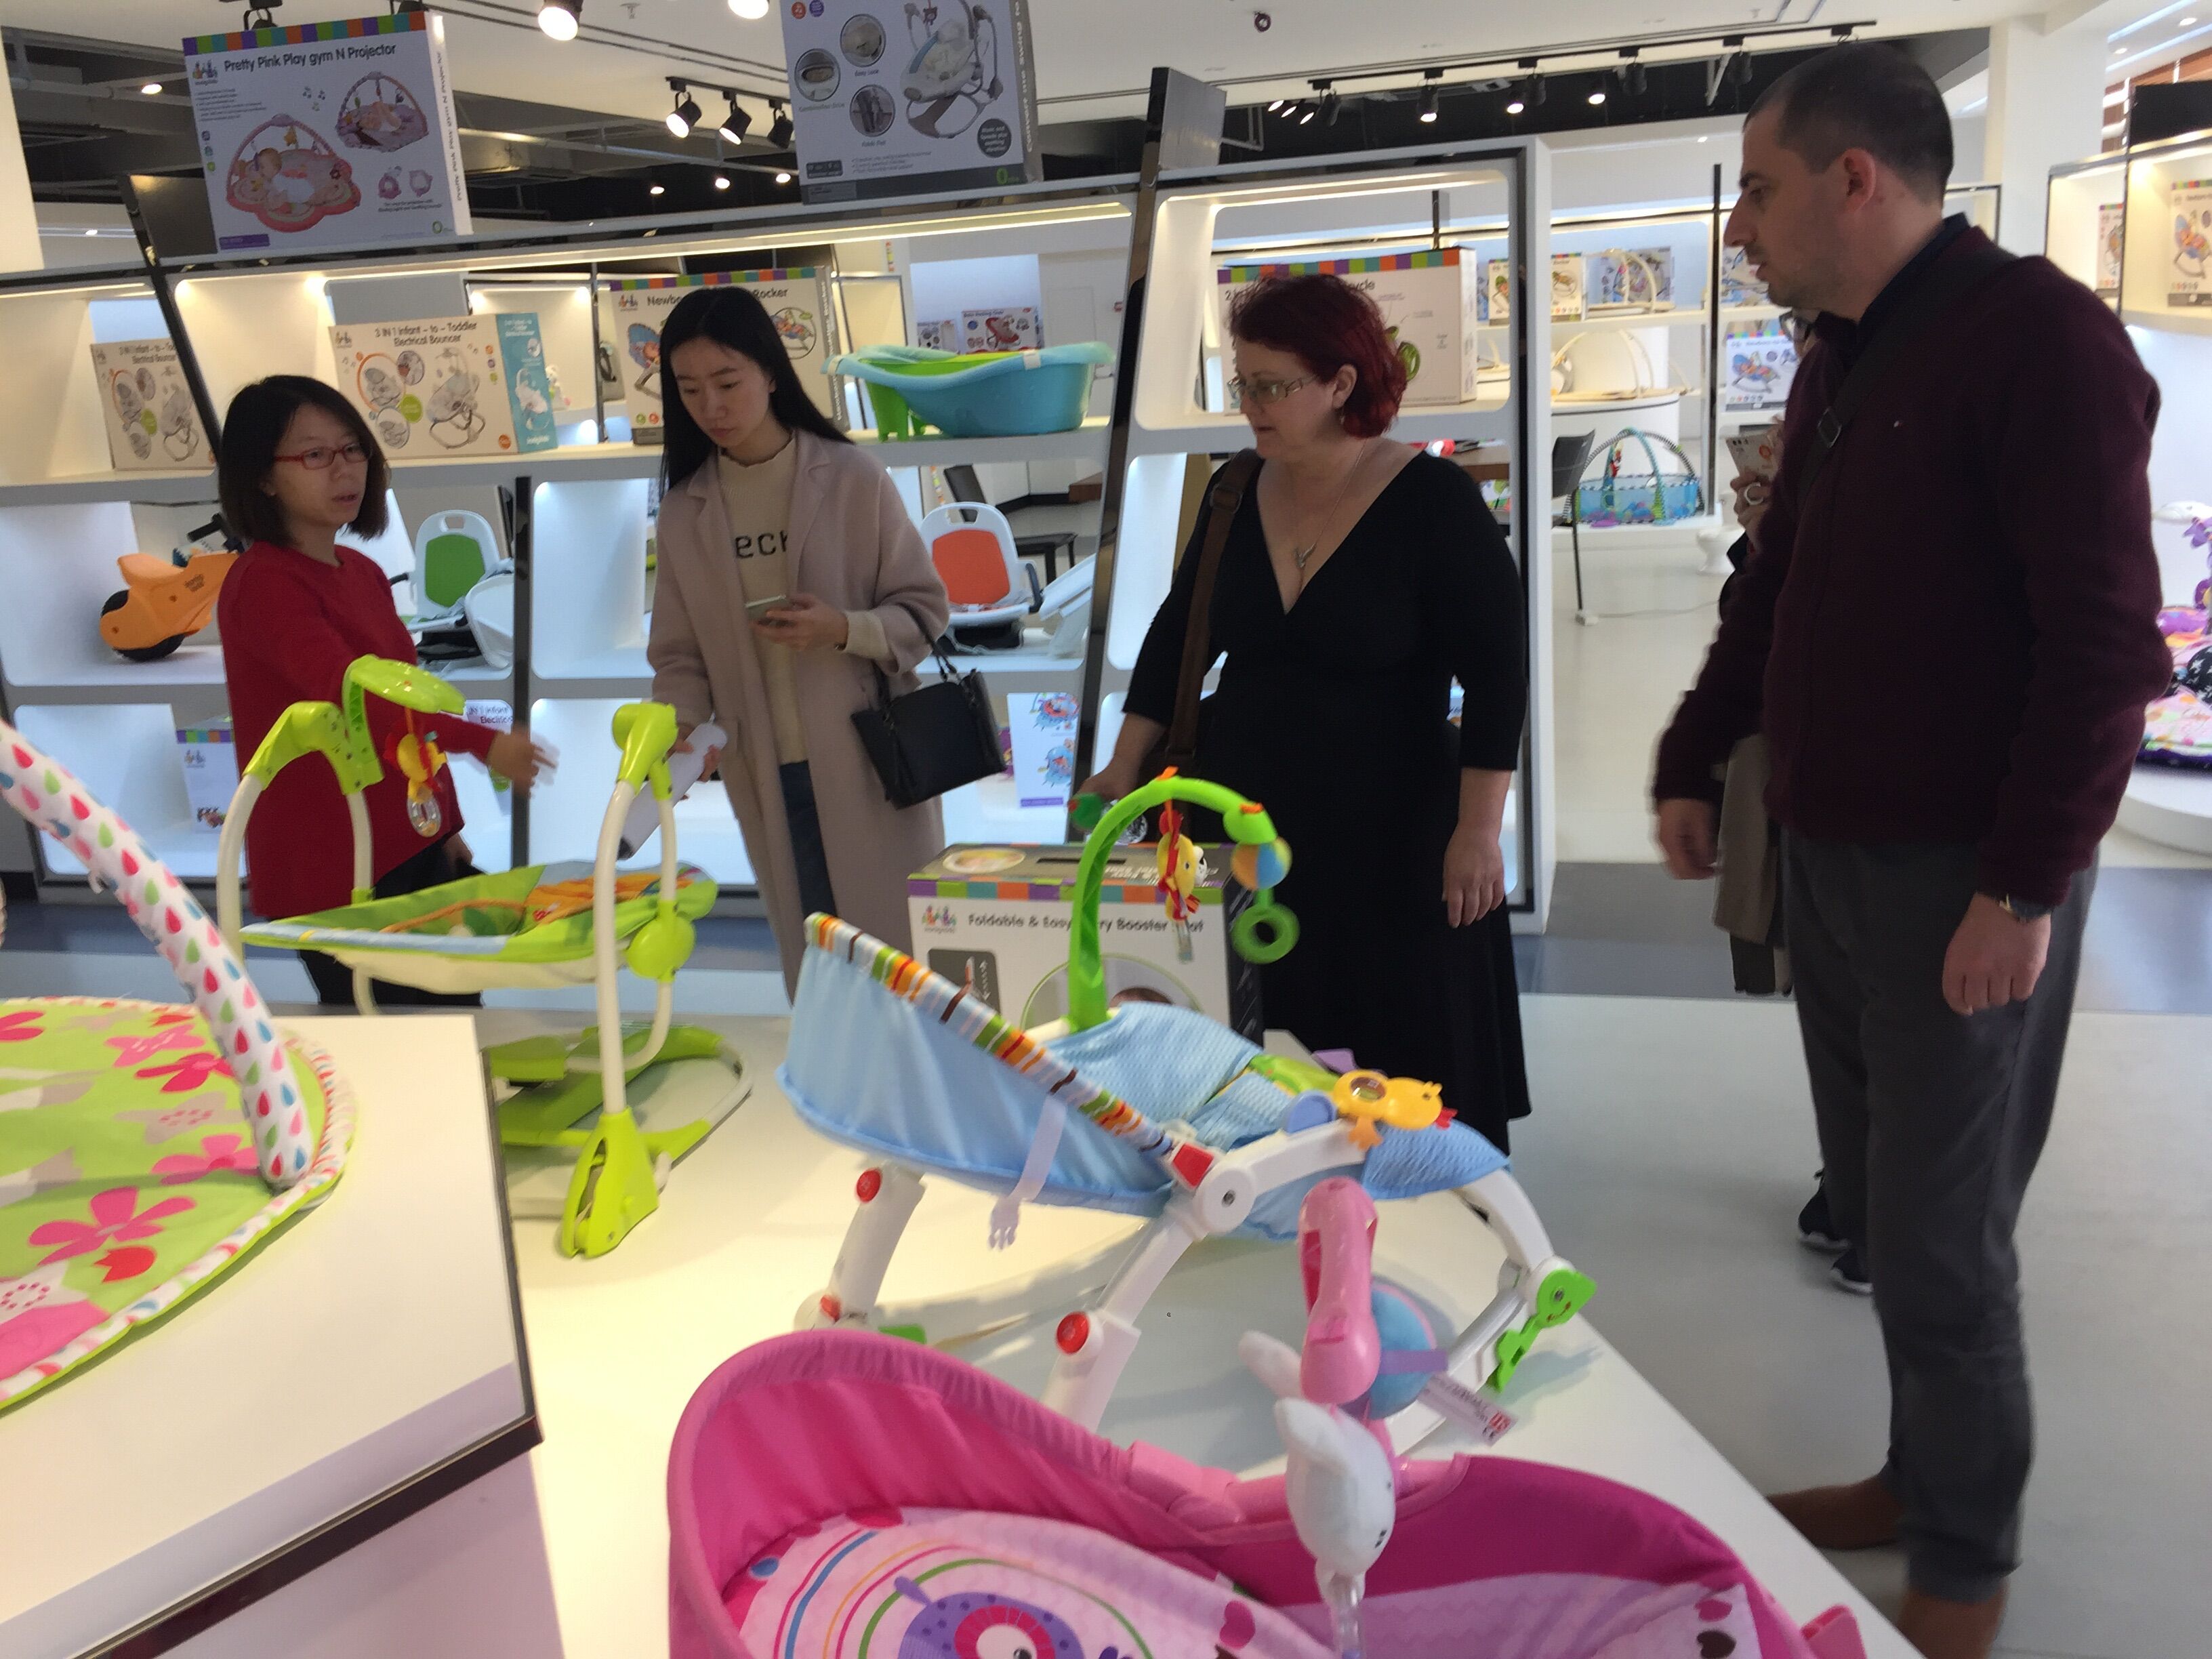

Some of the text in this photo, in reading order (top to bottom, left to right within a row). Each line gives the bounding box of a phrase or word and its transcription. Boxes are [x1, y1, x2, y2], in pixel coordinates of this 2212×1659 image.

[224, 44, 397, 73] Pretty Pink Play gym N Projector
[968, 914, 1025, 928] Foldable
[1029, 915, 1039, 927] &
[1043, 915, 1073, 930] Easy
[1117, 917, 1169, 932] Booster
